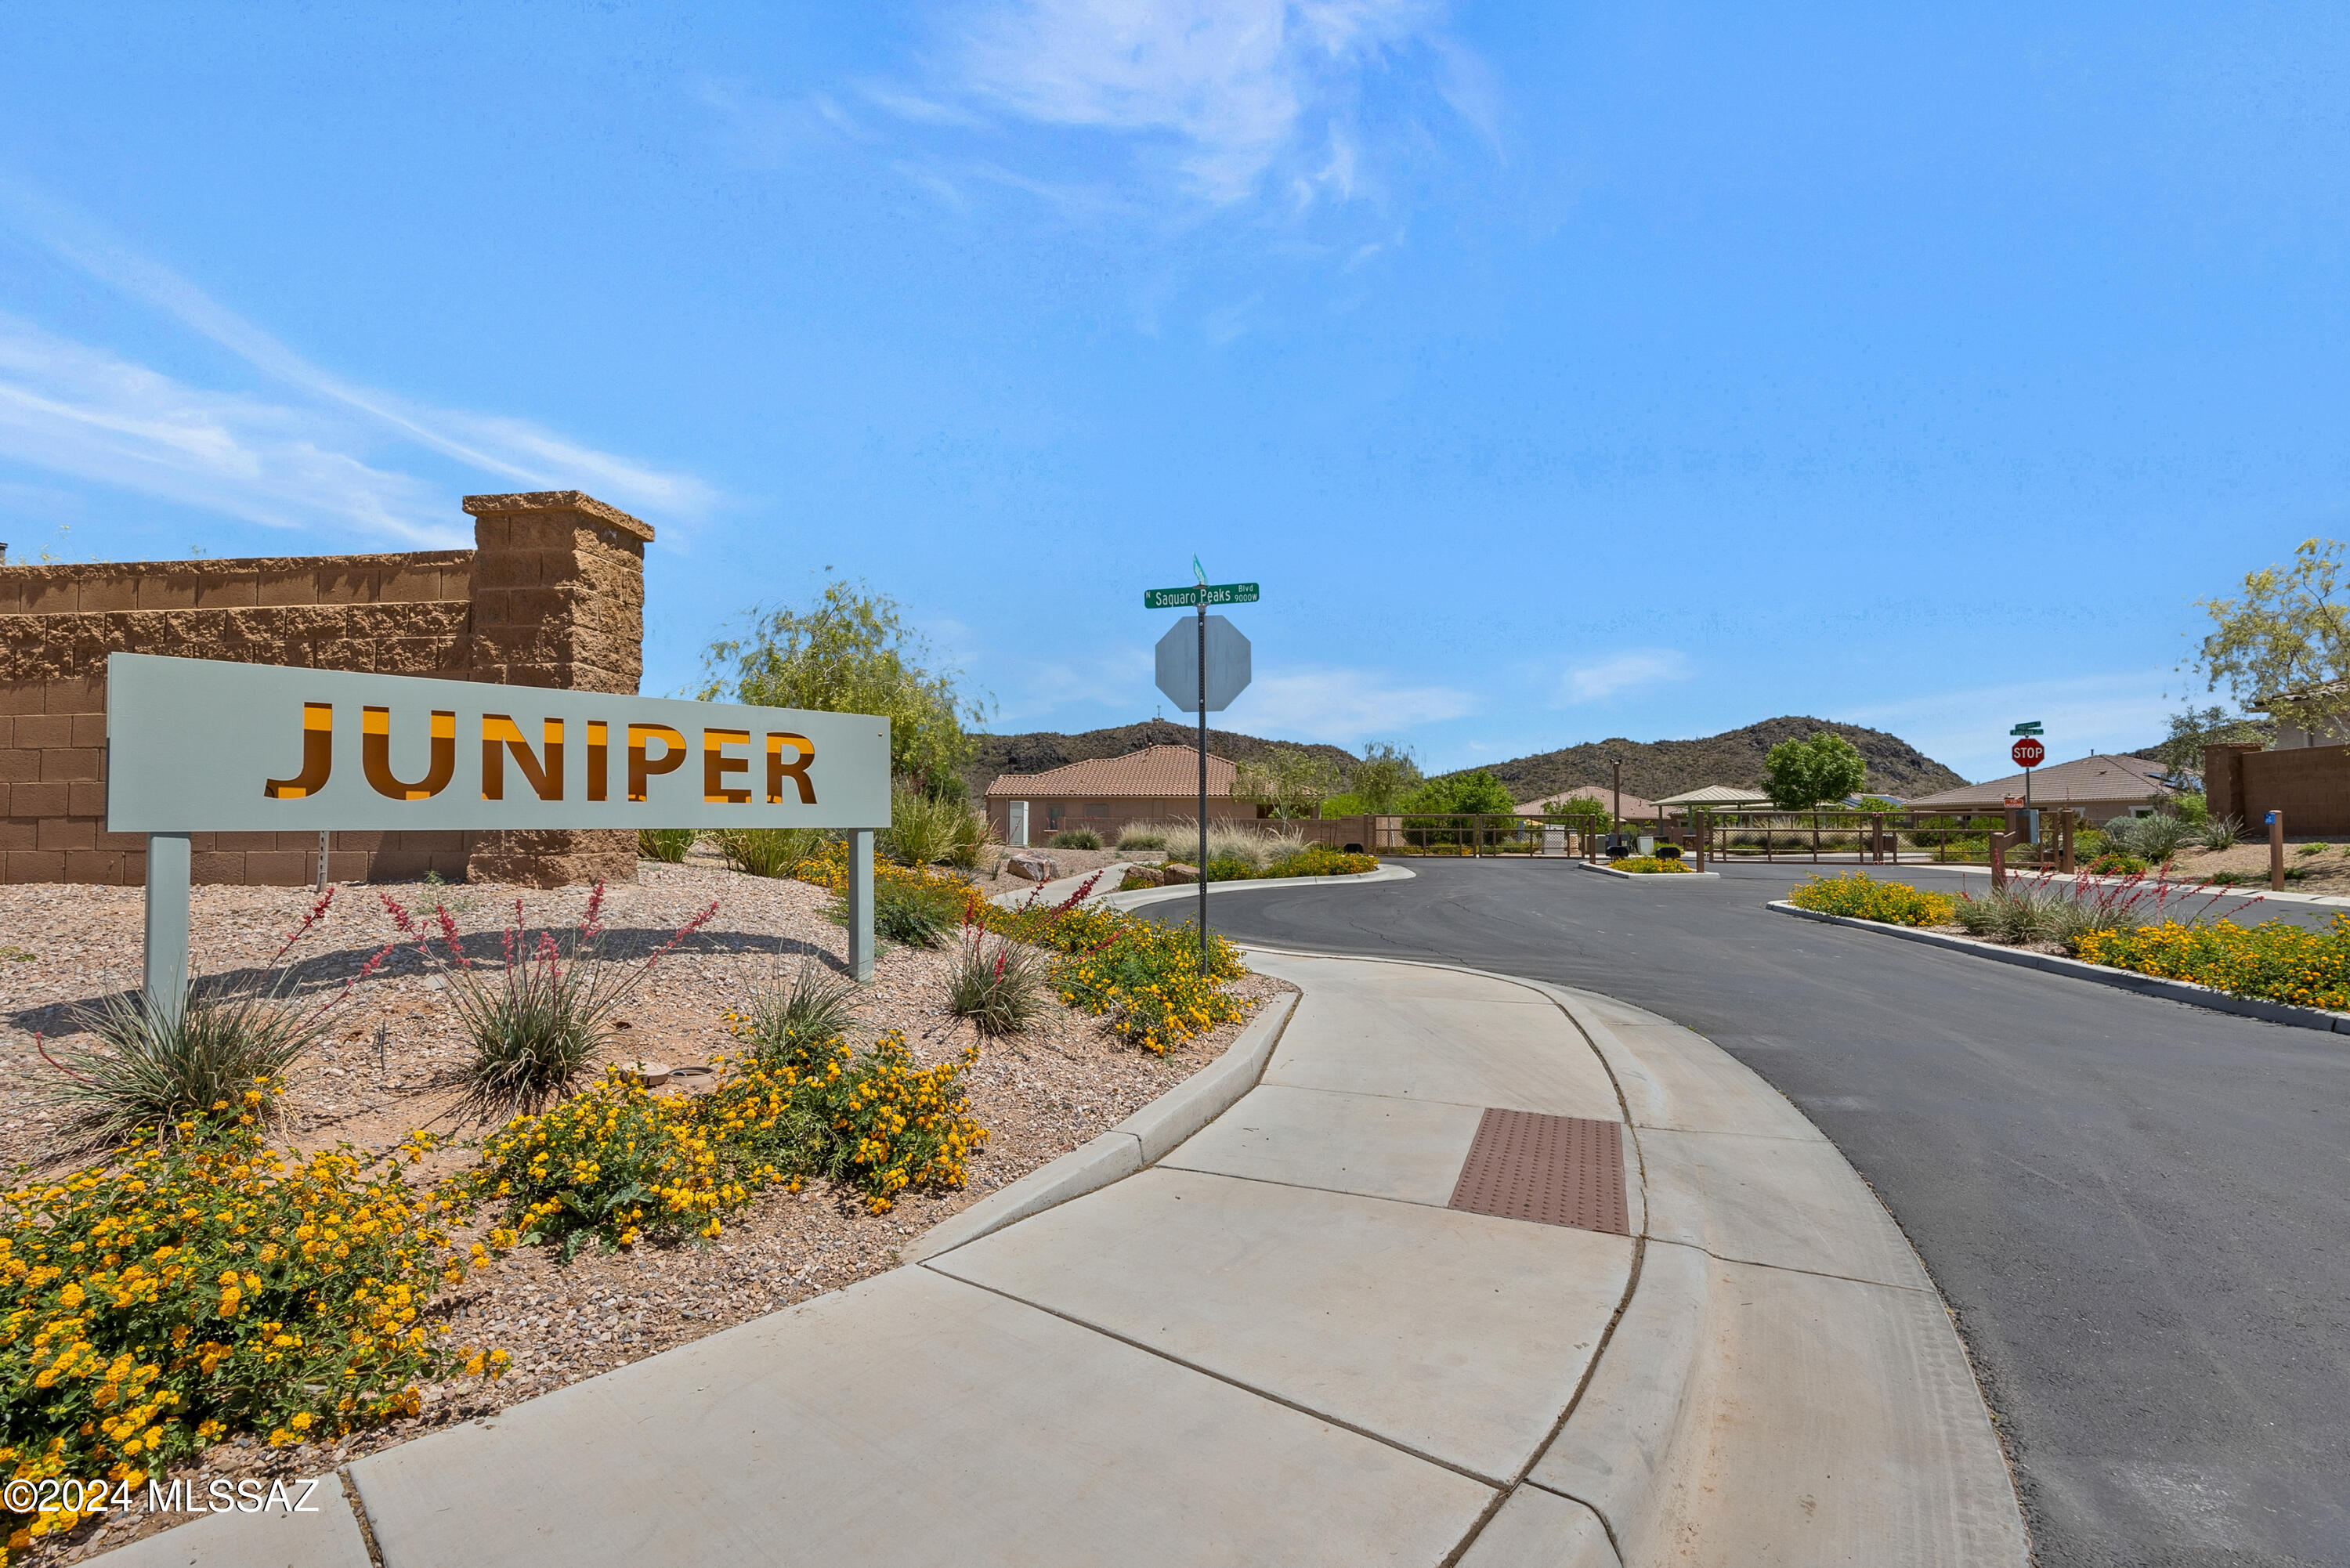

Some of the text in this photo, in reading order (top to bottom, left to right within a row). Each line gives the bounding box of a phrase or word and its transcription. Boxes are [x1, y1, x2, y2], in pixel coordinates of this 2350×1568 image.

[1200, 589, 1231, 603] Peaks
[1238, 584, 1253, 593] Blvd
[263, 702, 818, 804] JUNIPER
[2013, 746, 2043, 759] STOP
